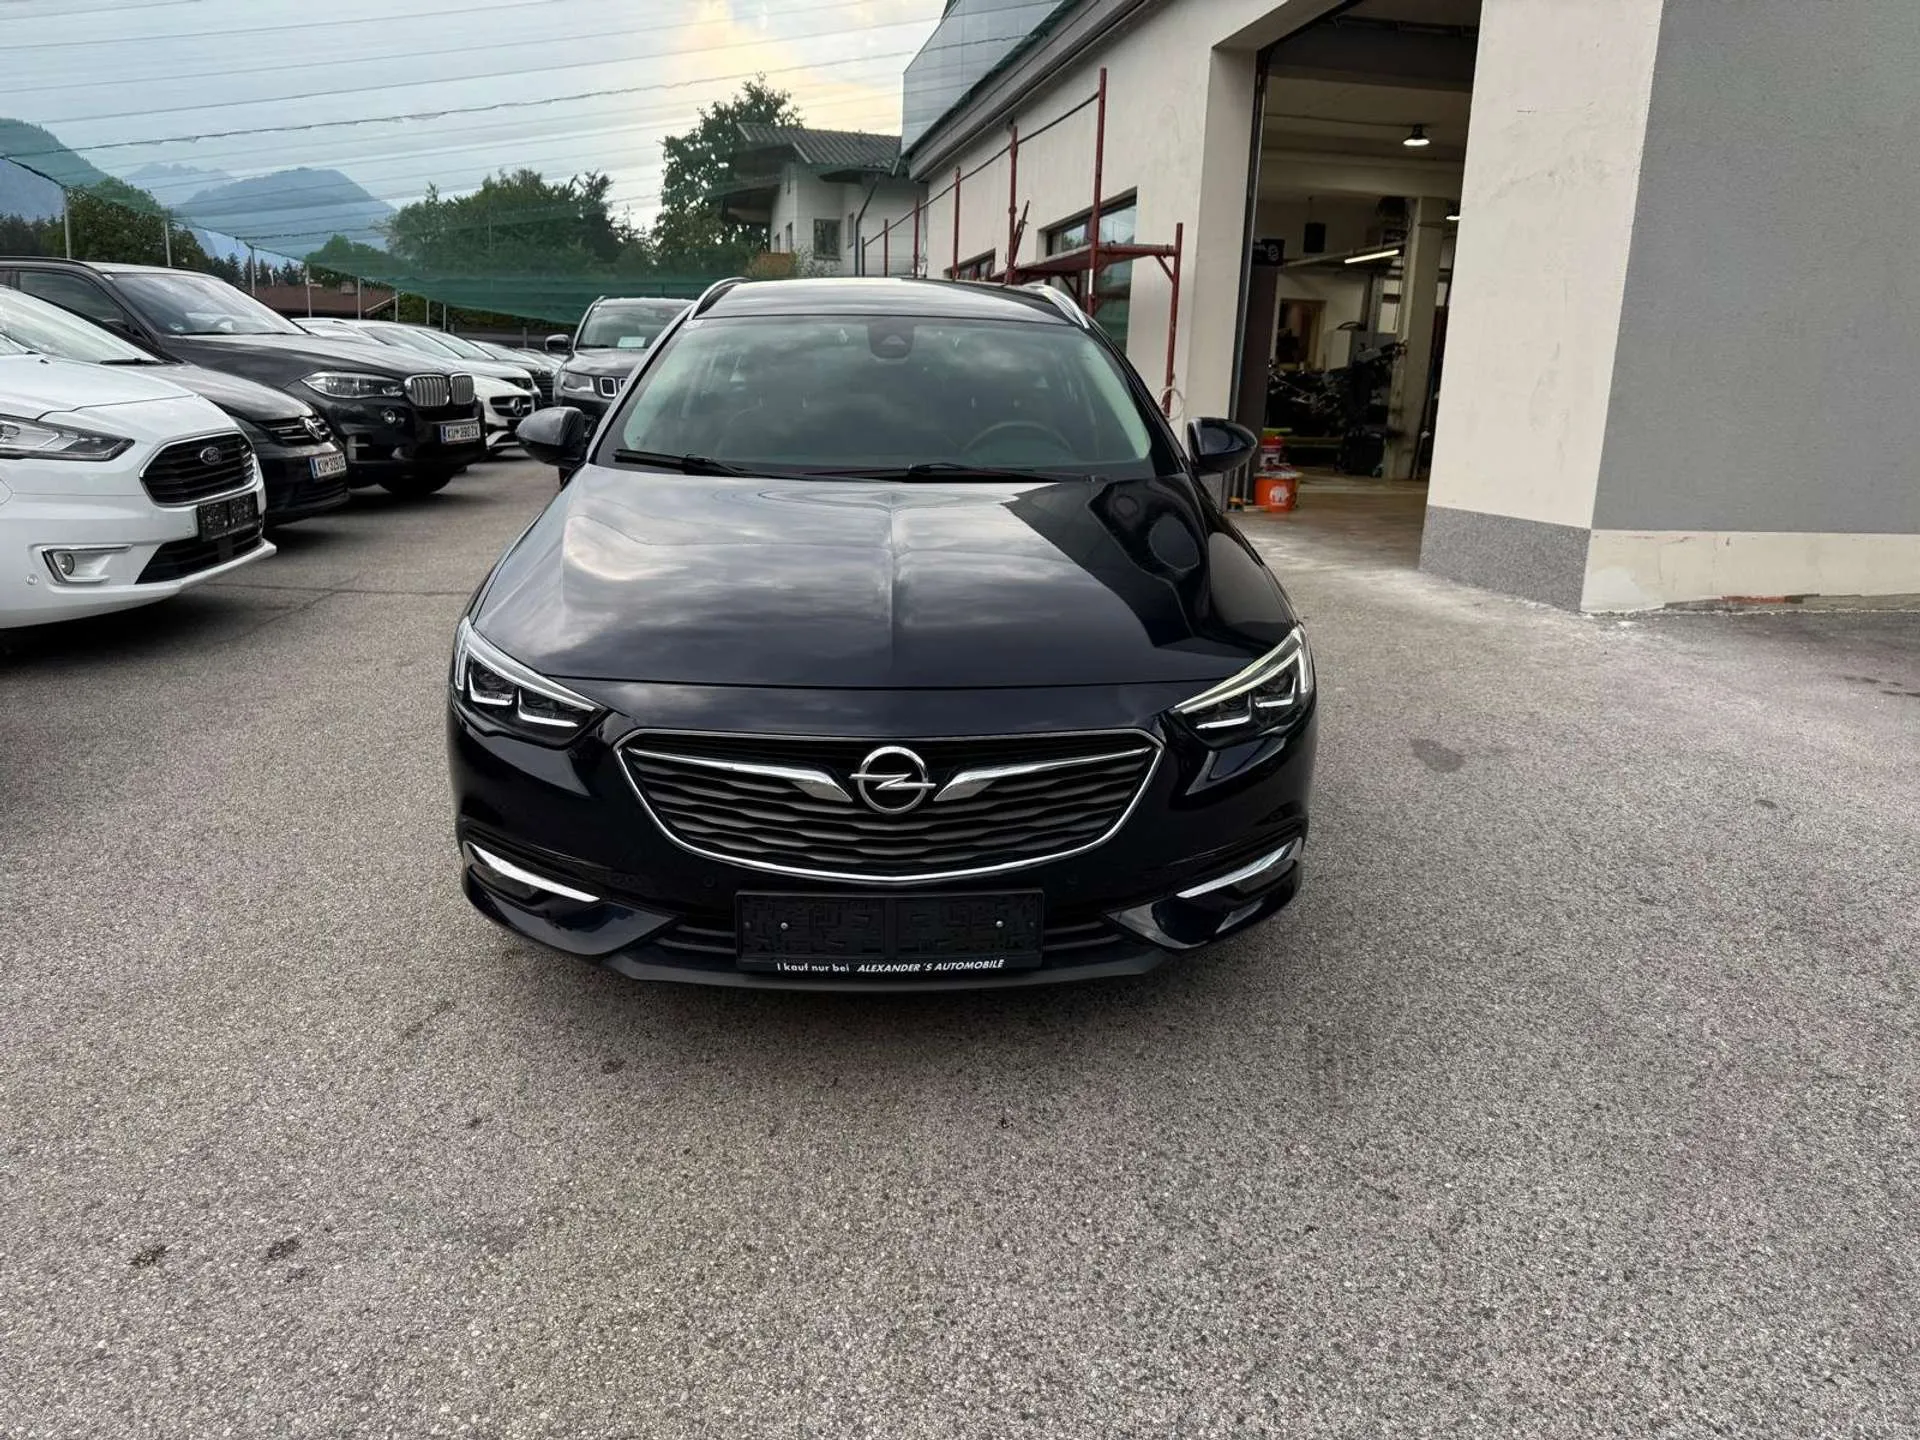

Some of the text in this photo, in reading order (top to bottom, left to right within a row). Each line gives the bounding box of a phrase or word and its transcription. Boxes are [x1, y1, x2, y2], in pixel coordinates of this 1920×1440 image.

[783, 962, 808, 972] kauf
[832, 963, 850, 972] bei
[934, 959, 1005, 971] AUTOMOBILE
